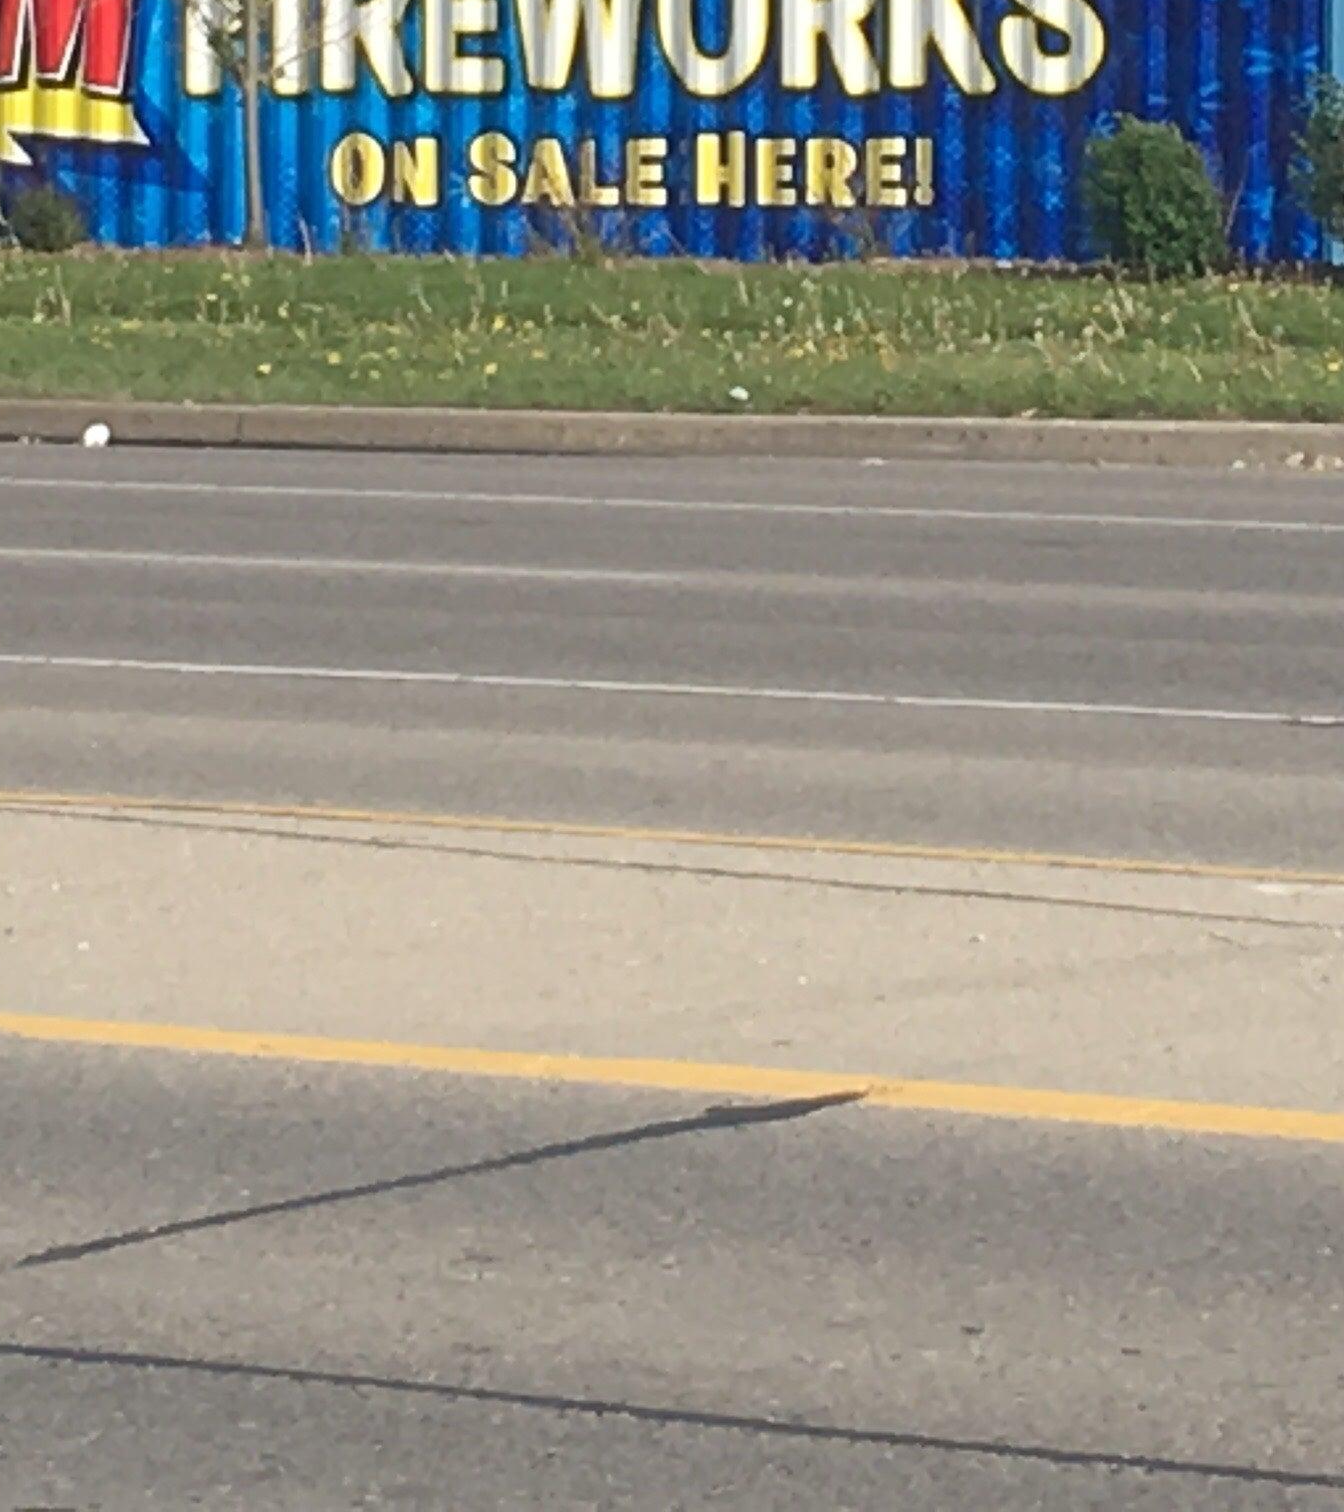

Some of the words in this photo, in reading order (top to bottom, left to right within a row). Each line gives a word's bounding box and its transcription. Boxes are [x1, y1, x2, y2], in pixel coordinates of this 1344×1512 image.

[328, 131, 440, 208] ON
[467, 130, 669, 209] SALE
[693, 128, 936, 209] HERE!
